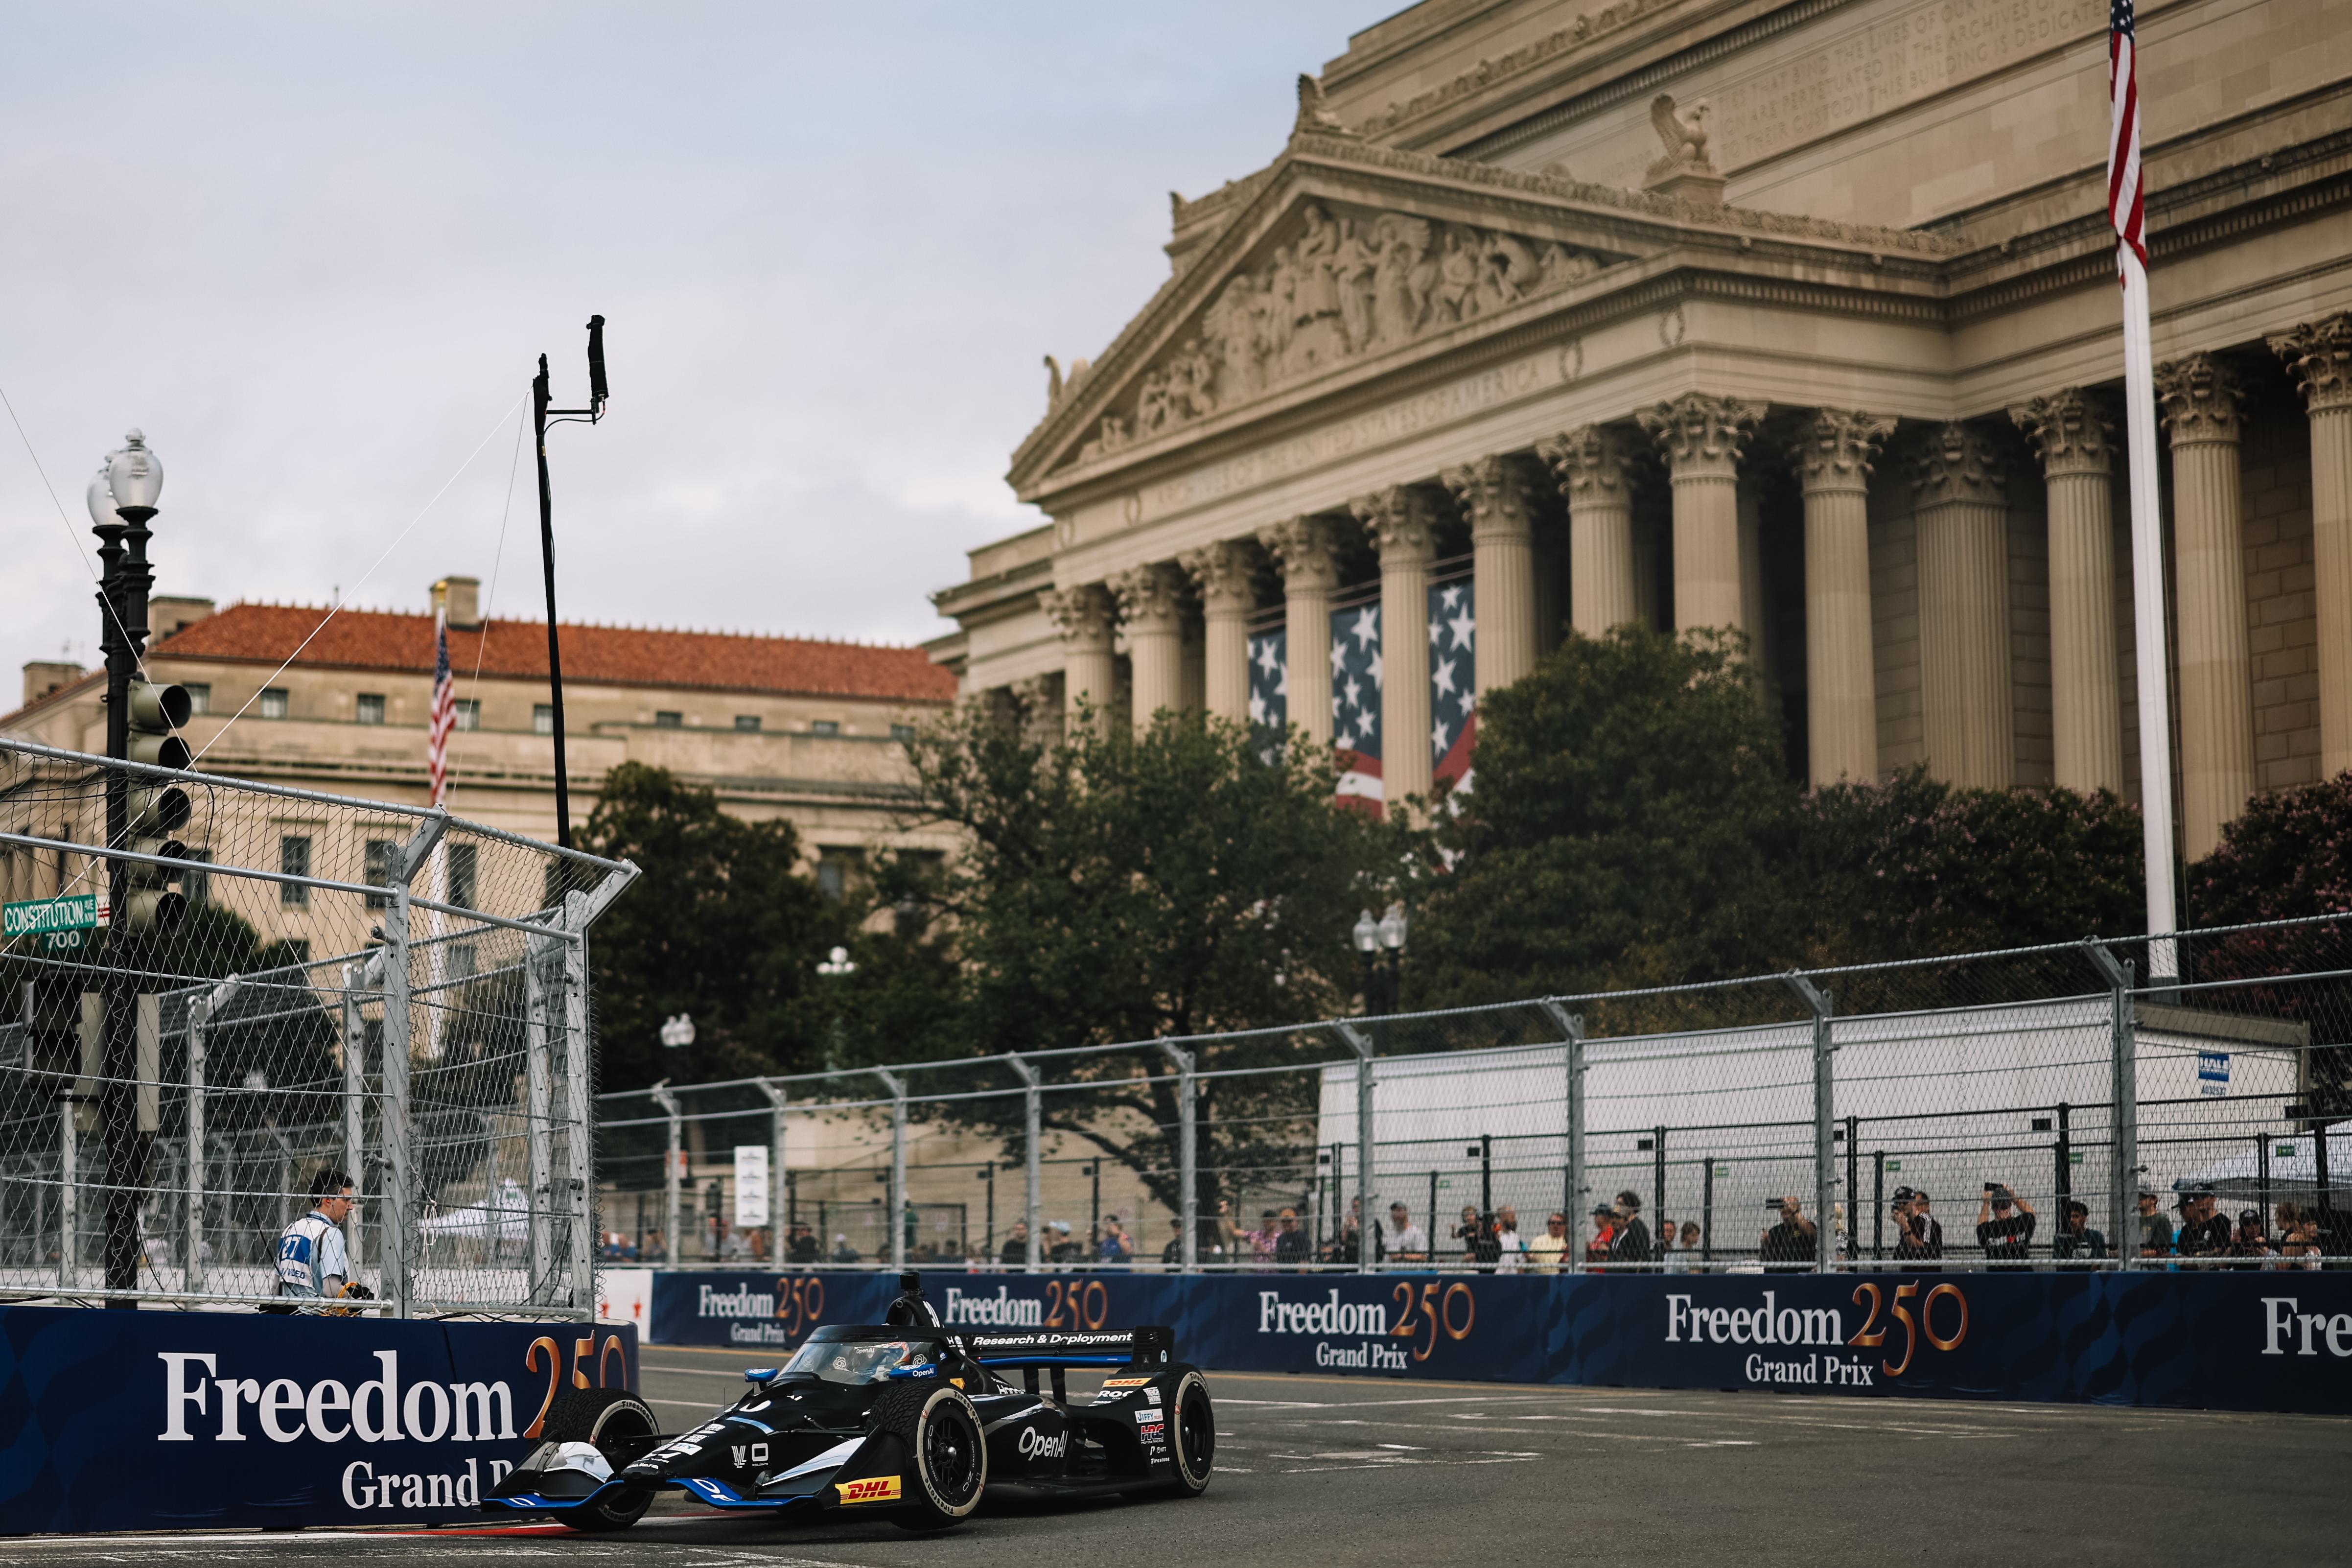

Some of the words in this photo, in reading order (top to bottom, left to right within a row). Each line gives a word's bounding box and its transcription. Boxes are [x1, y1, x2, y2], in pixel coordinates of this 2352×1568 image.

[2015, 0, 2110, 47] DEDICATE
[4, 900, 83, 932] CONSTITUTION
[46, 930, 80, 949] 700
[699, 1283, 774, 1318] Freedom
[775, 1277, 824, 1336] 250
[945, 1286, 1043, 1326] Freedom
[1045, 1280, 1107, 1330] 250
[1258, 1288, 1387, 1335] Freedom
[1390, 1279, 1475, 1361] 250
[731, 1322, 763, 1342] Grand
[973, 1334, 1035, 1346] Research
[1036, 1334, 1048, 1344] &
[1665, 1290, 1844, 1345] Freedom
[1847, 1279, 1969, 1377] 250
[1316, 1341, 1369, 1368] Grand
[1372, 1343, 1408, 1370] Prix
[1745, 1353, 1818, 1384] Grand
[1823, 1355, 1874, 1386] Prix
[912, 1367, 934, 1378] OpenAI
[158, 1350, 518, 1443] Freedom
[621, 1401, 653, 1424] Firestone
[954, 1390, 981, 1429] Firestone
[1137, 1412, 1153, 1421] JIFFY
[1019, 1426, 1069, 1461] OpenAI
[342, 1457, 481, 1509] Grand
[847, 1480, 892, 1499] DHL
[1182, 1462, 1204, 1488] Firestone
[925, 1476, 955, 1515] Firestone
